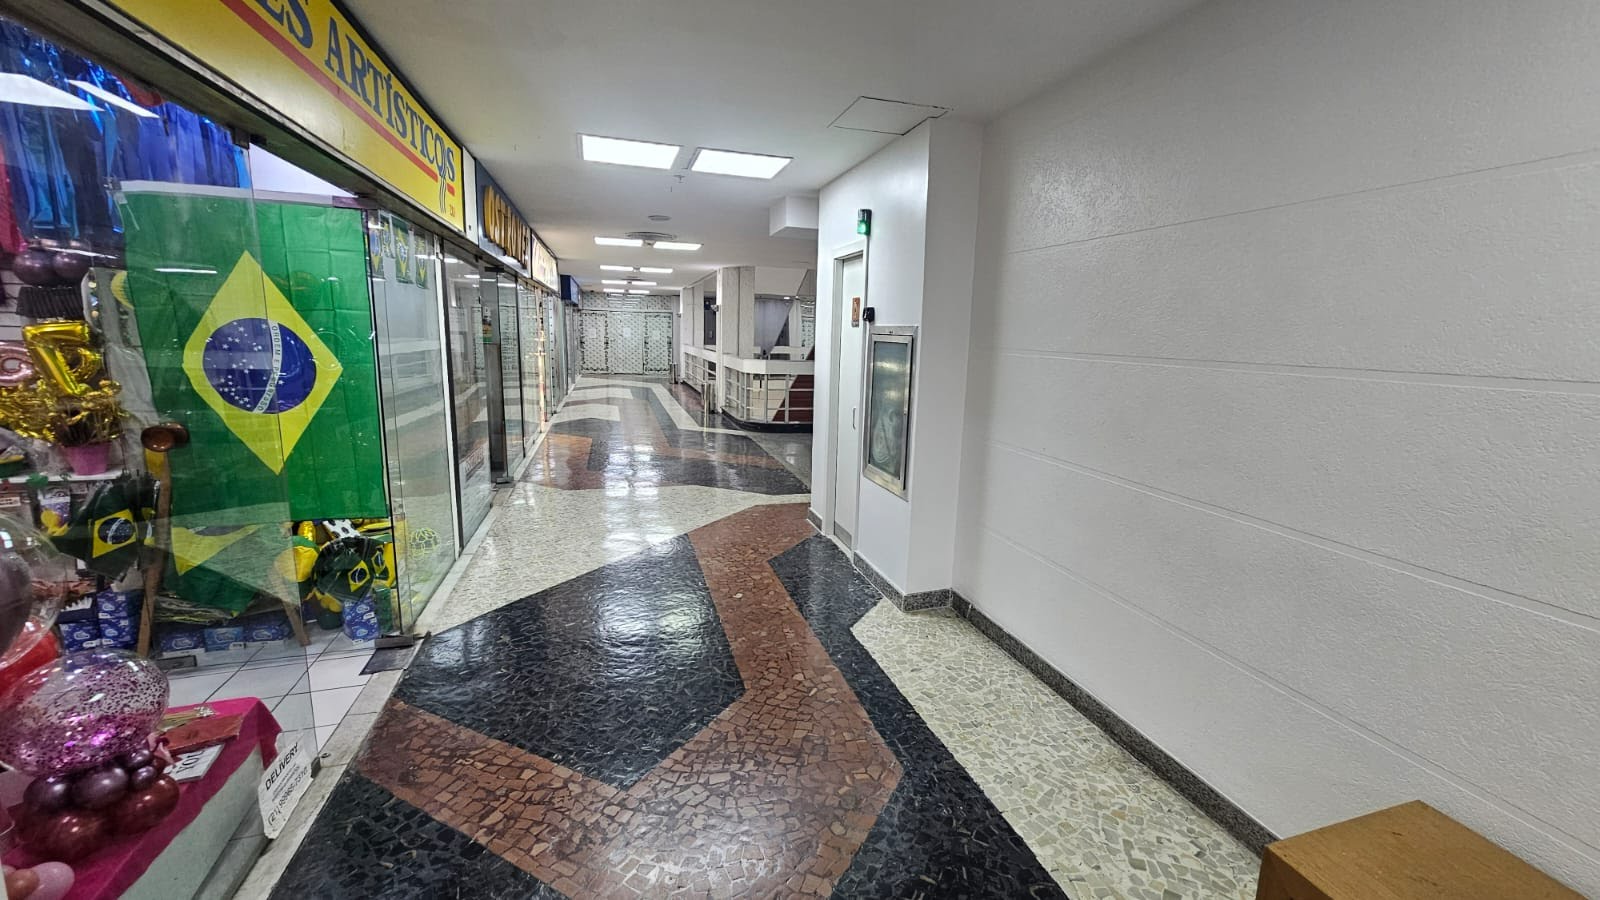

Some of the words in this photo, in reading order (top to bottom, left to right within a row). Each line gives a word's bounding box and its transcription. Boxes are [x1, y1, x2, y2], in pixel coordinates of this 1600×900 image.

[255, 0, 313, 49] S
[324, 16, 455, 182] ARTÍSTICOS
[271, 325, 281, 356] ORDEM
[265, 742, 298, 791] DELIVERY
